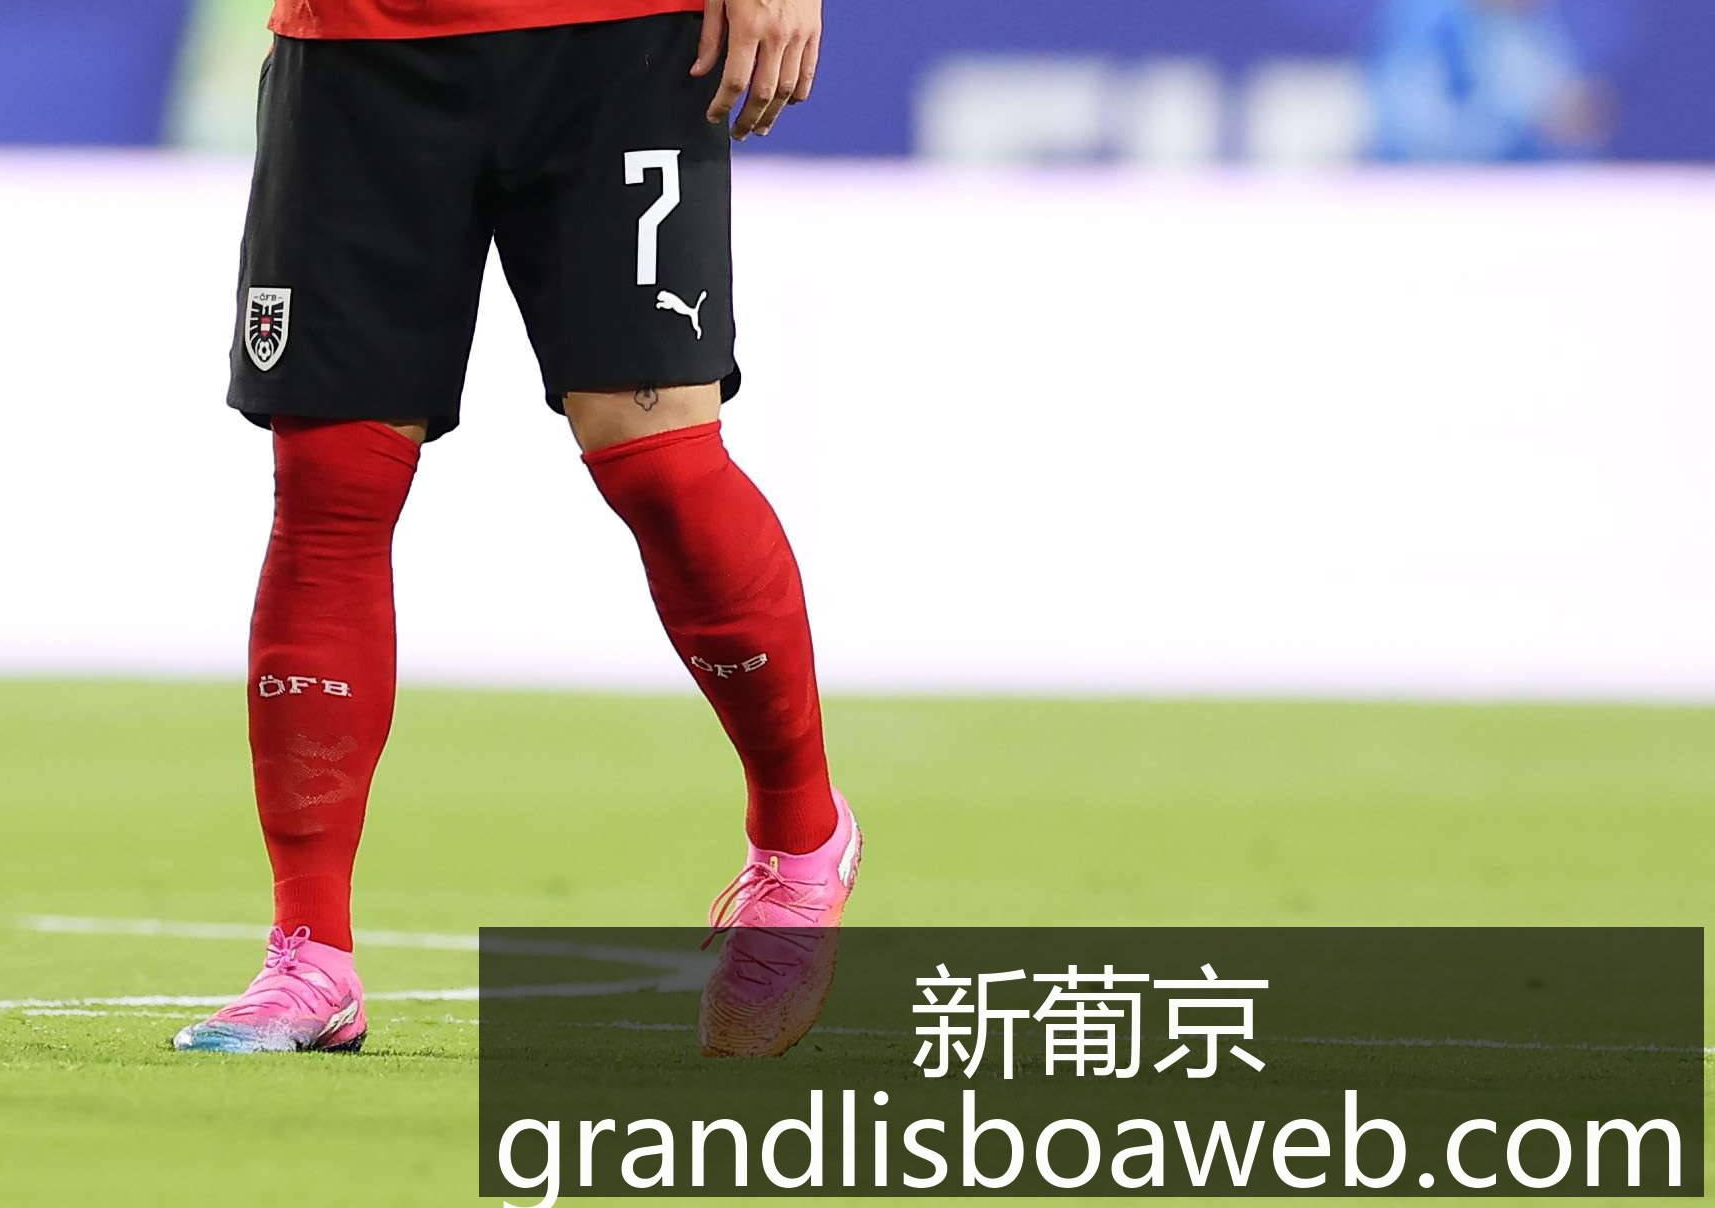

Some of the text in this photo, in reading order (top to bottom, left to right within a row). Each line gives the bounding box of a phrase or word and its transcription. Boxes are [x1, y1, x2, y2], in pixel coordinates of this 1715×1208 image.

[624, 148, 682, 286] 7
[690, 652, 769, 679] ÖFB
[258, 674, 352, 698] ÖFB
